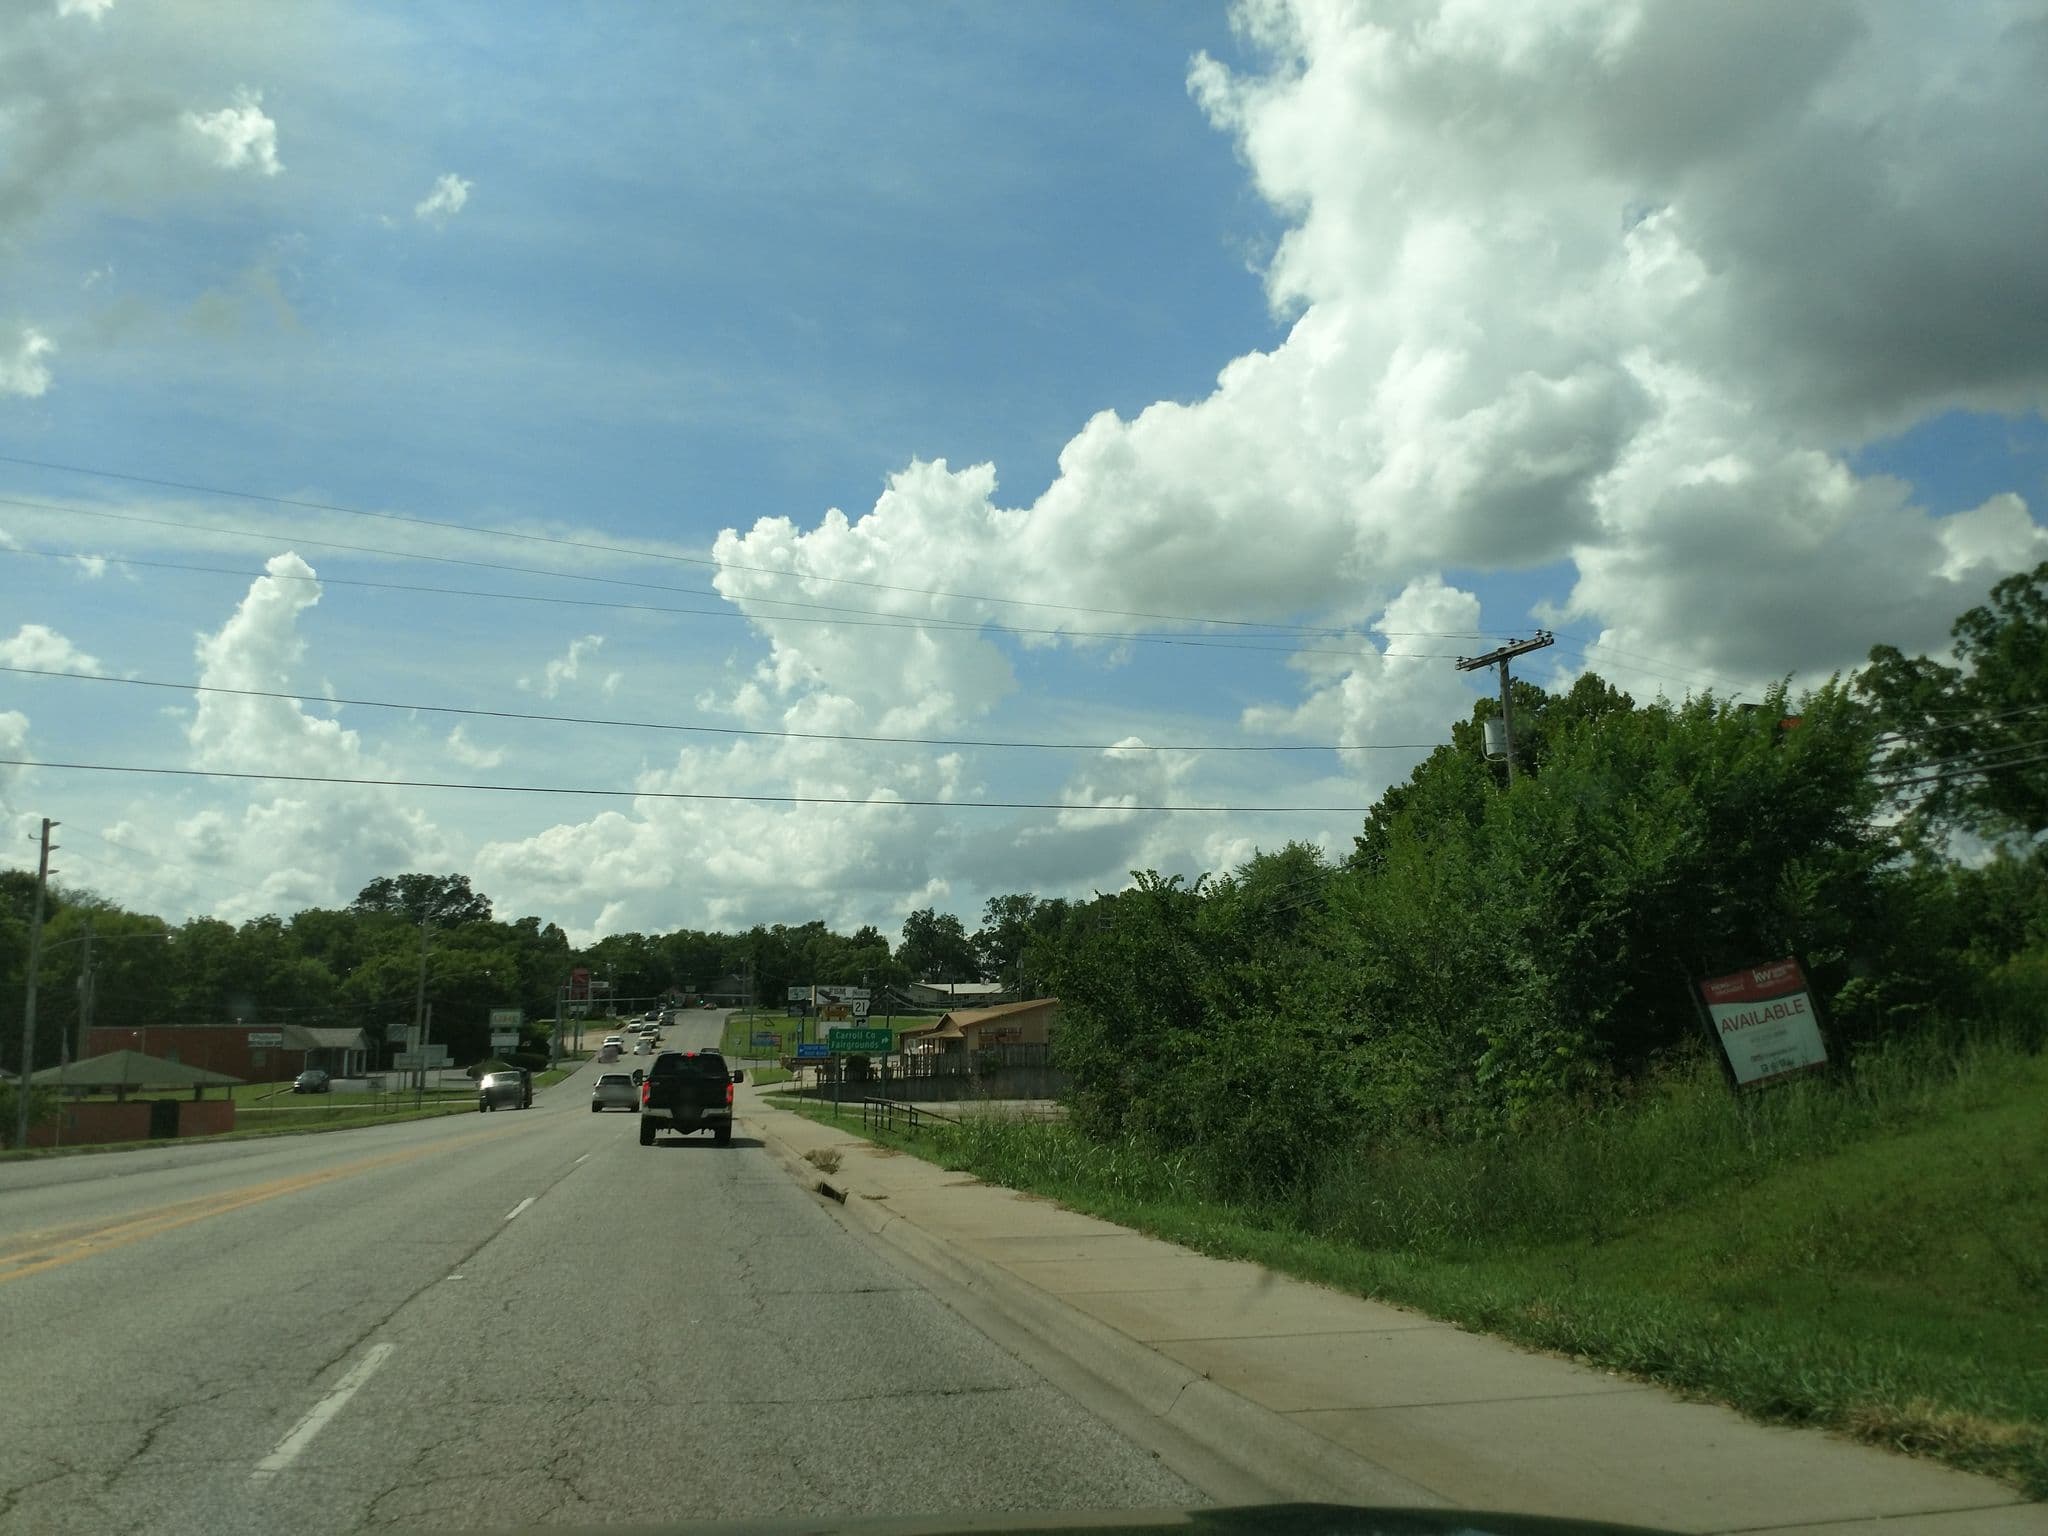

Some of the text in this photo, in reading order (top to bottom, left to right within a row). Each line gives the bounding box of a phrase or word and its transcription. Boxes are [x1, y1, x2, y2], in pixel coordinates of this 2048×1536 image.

[855, 1002, 865, 1012] 21
[1721, 998, 1805, 1034] AVAILABLE
[835, 1031, 863, 1040] Carroll
[831, 1040, 879, 1050] Fairgrounds
